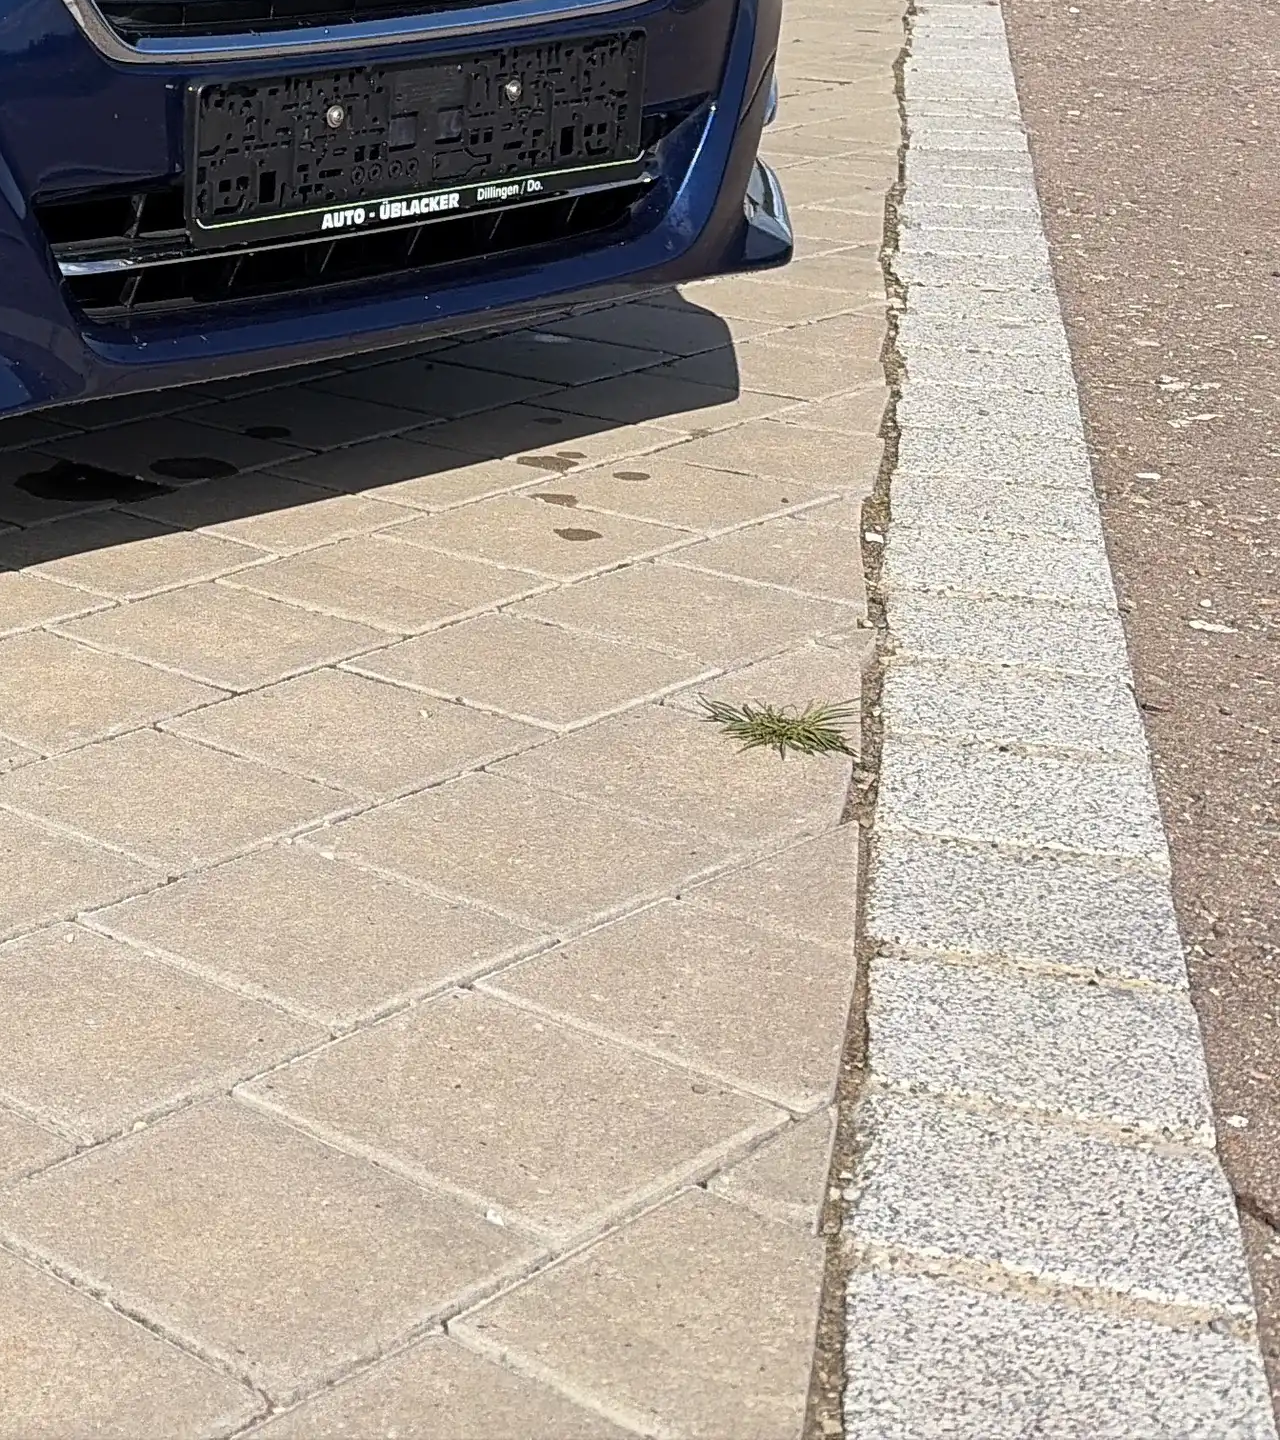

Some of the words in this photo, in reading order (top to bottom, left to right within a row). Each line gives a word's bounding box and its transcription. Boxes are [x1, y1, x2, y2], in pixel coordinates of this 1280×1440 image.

[321, 208, 365, 230] AUTO
[379, 193, 460, 221] ÜBLACKER
[476, 185, 520, 202] Dillingen
[527, 179, 544, 192] Do.
